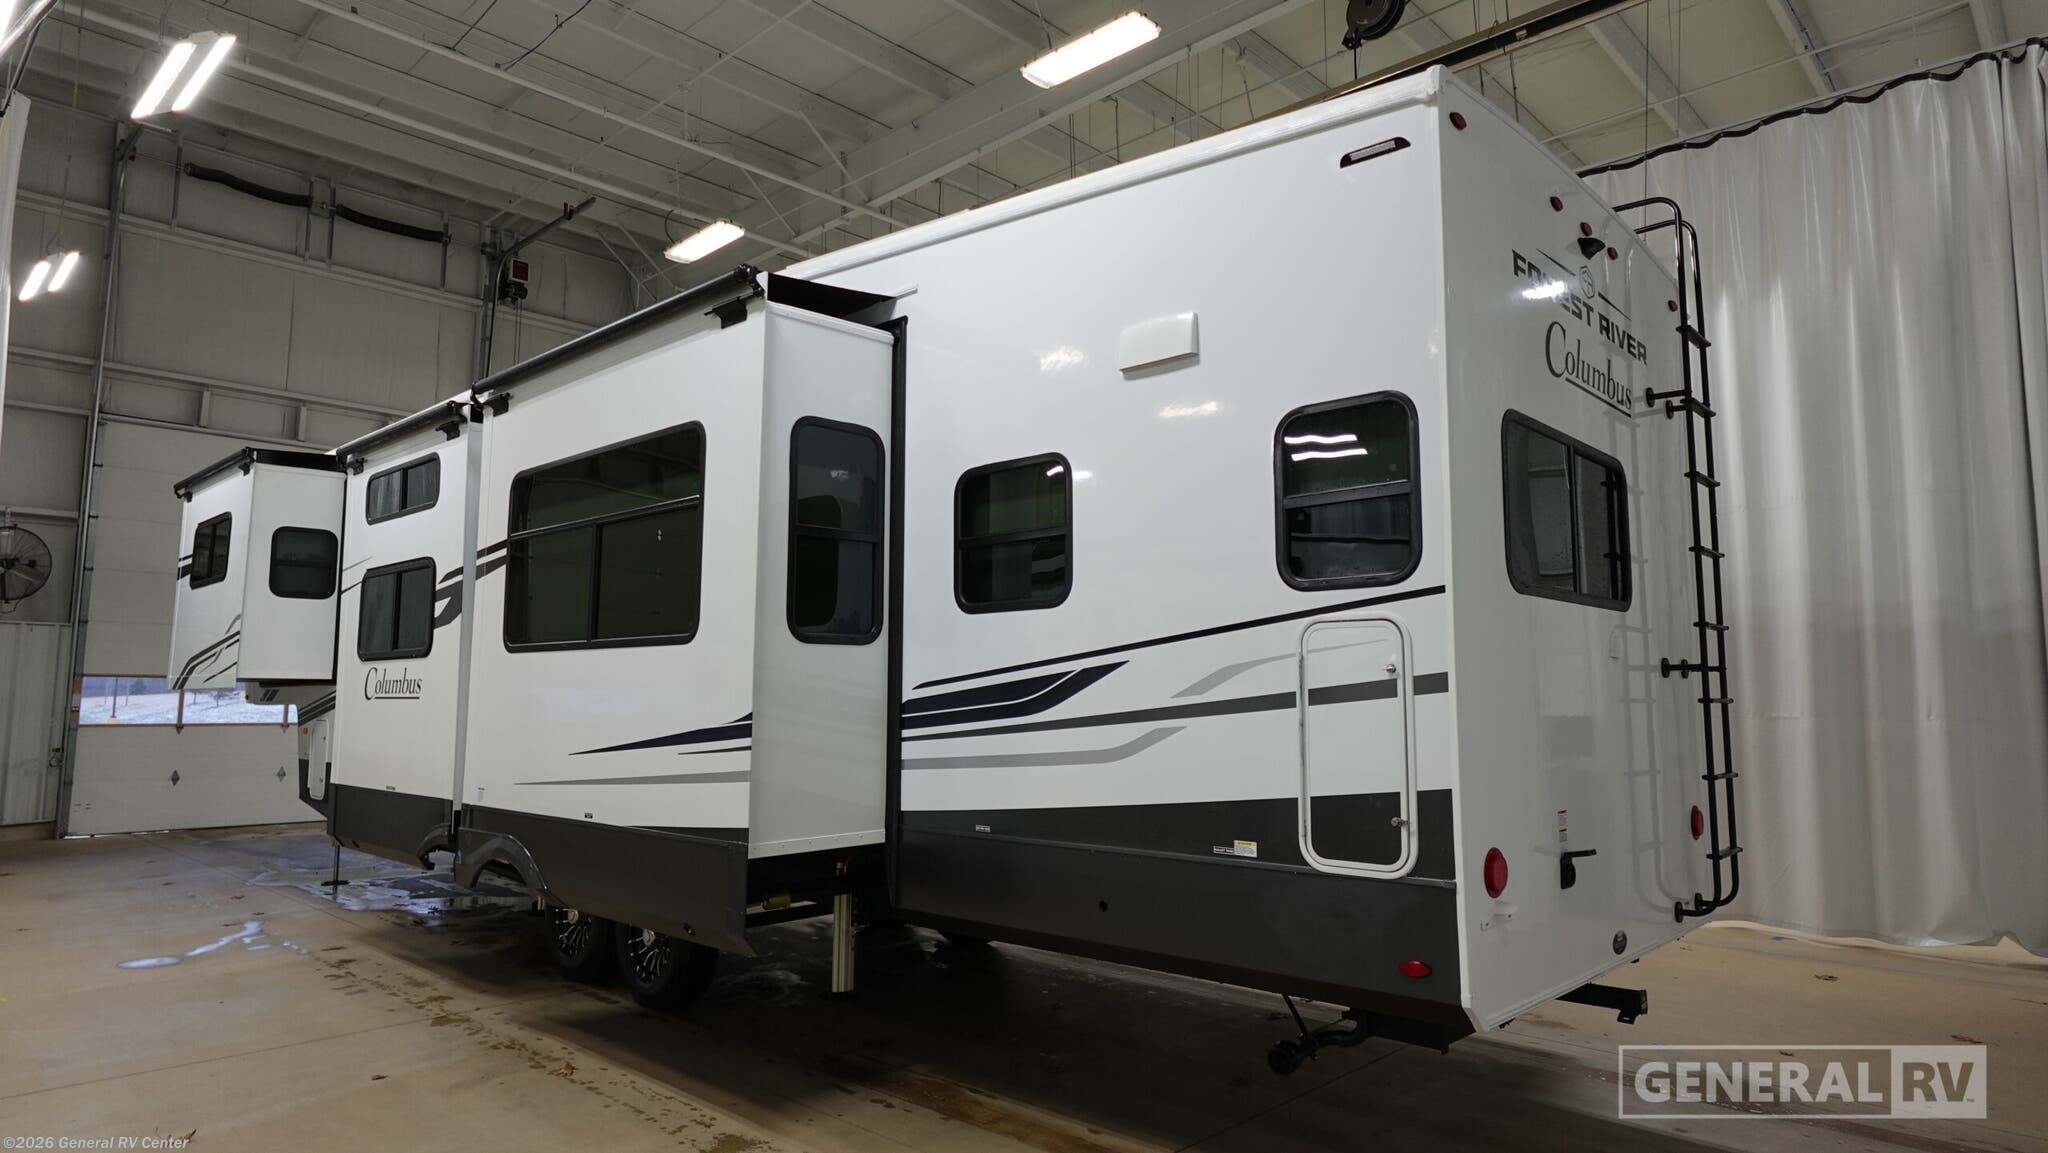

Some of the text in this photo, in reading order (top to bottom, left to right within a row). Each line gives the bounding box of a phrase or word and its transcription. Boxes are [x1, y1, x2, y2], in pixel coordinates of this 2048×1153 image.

[1598, 311, 1648, 365] RIVER
[1545, 321, 1632, 411] Columbus
[365, 666, 422, 700] Columbus
